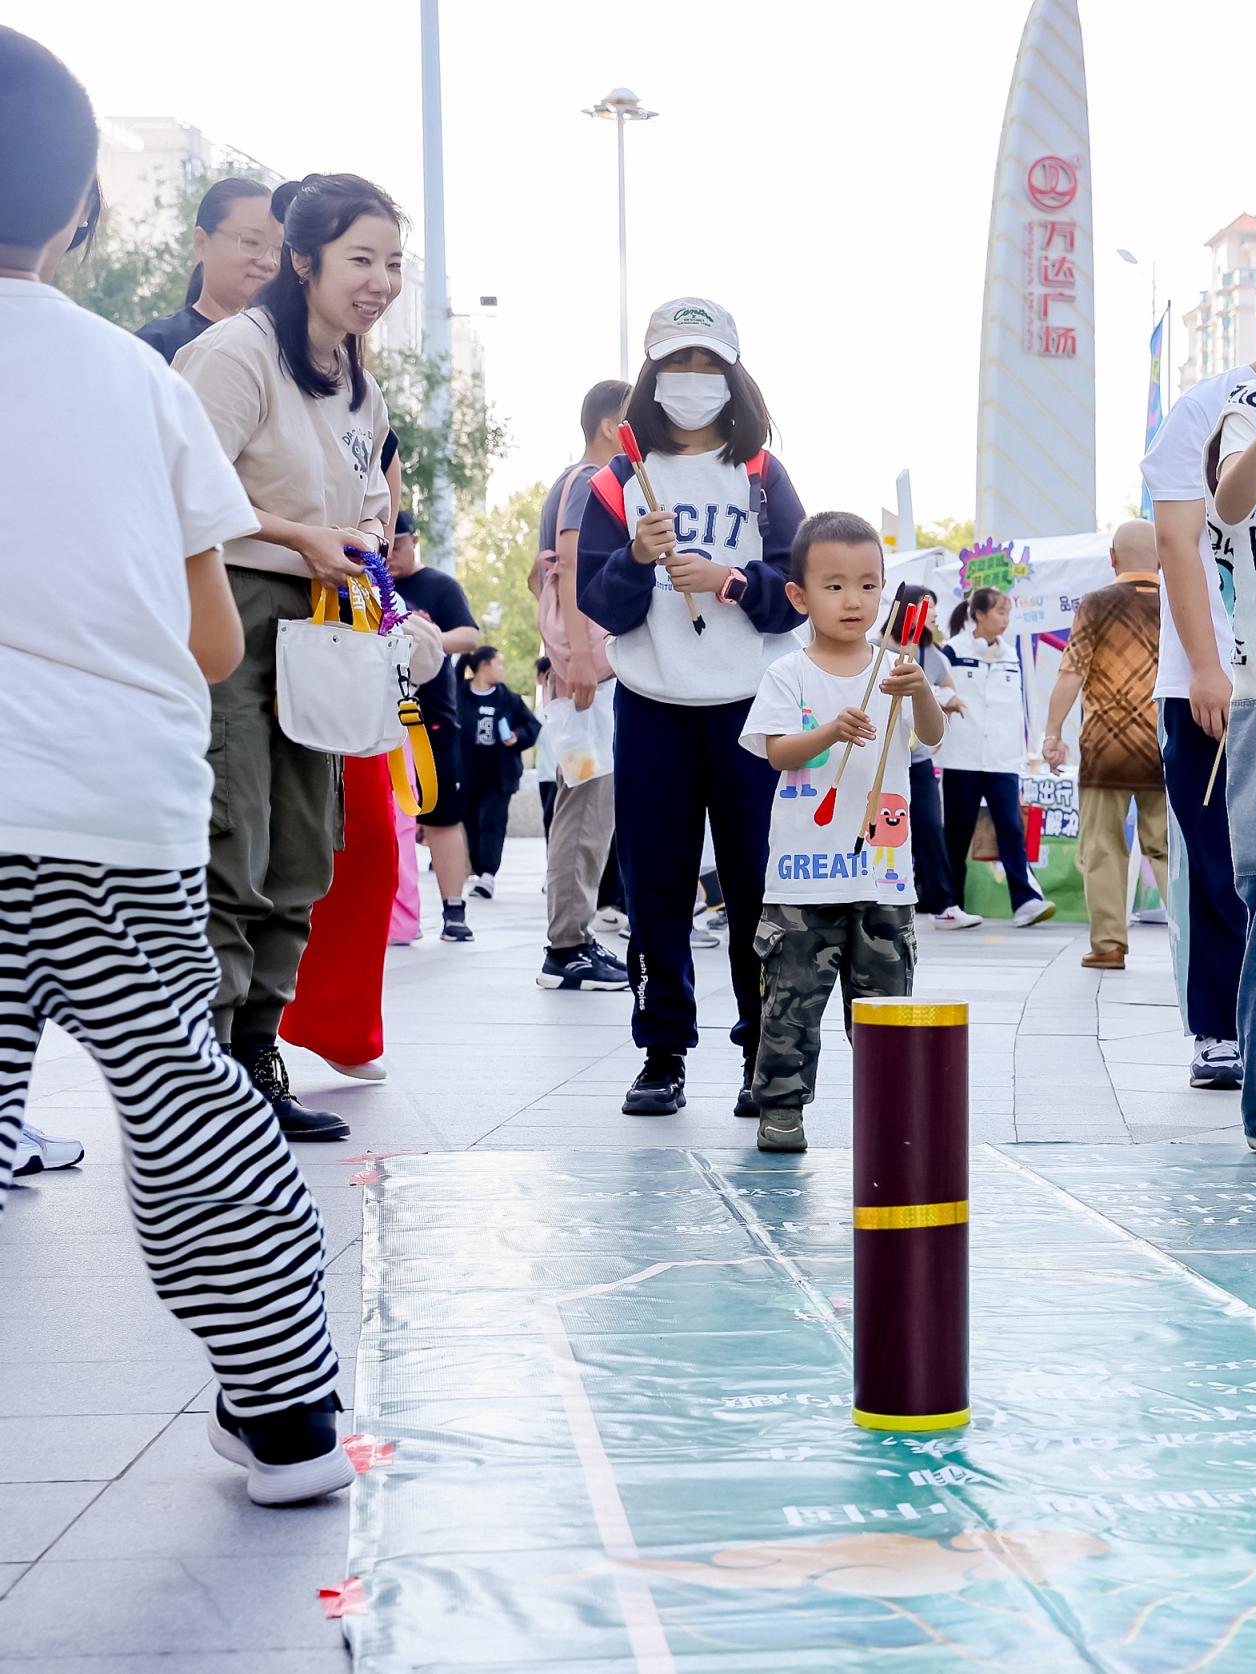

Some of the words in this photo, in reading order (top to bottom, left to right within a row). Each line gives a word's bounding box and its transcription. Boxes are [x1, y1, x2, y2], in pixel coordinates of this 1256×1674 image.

[1040, 221, 1076, 357] 万达广场
[637, 503, 749, 550] CIT
[777, 850, 869, 880] GREAT!
